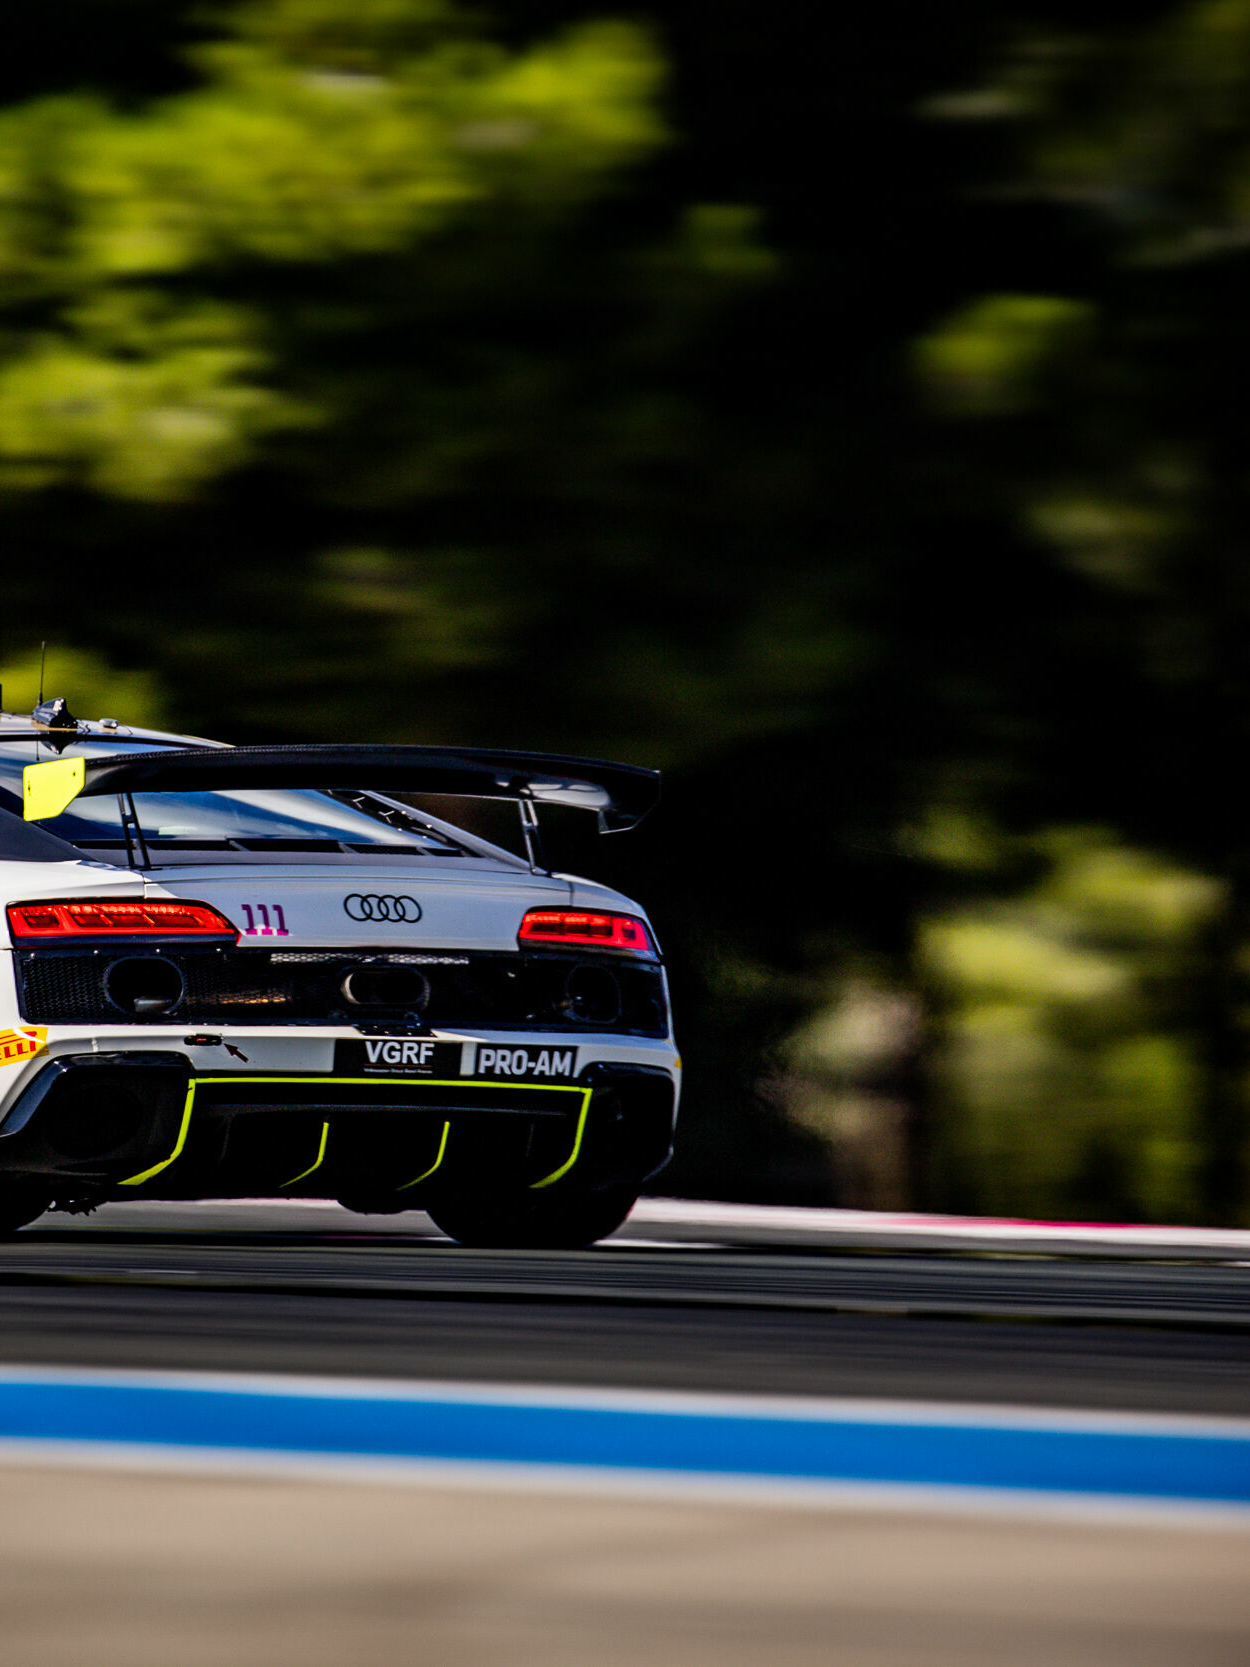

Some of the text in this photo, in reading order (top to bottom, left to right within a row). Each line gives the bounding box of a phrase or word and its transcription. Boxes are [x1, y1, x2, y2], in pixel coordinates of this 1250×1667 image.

[241, 903, 289, 936] 111
[365, 1041, 435, 1065] VGRF
[478, 1048, 573, 1077] PRO-AM
